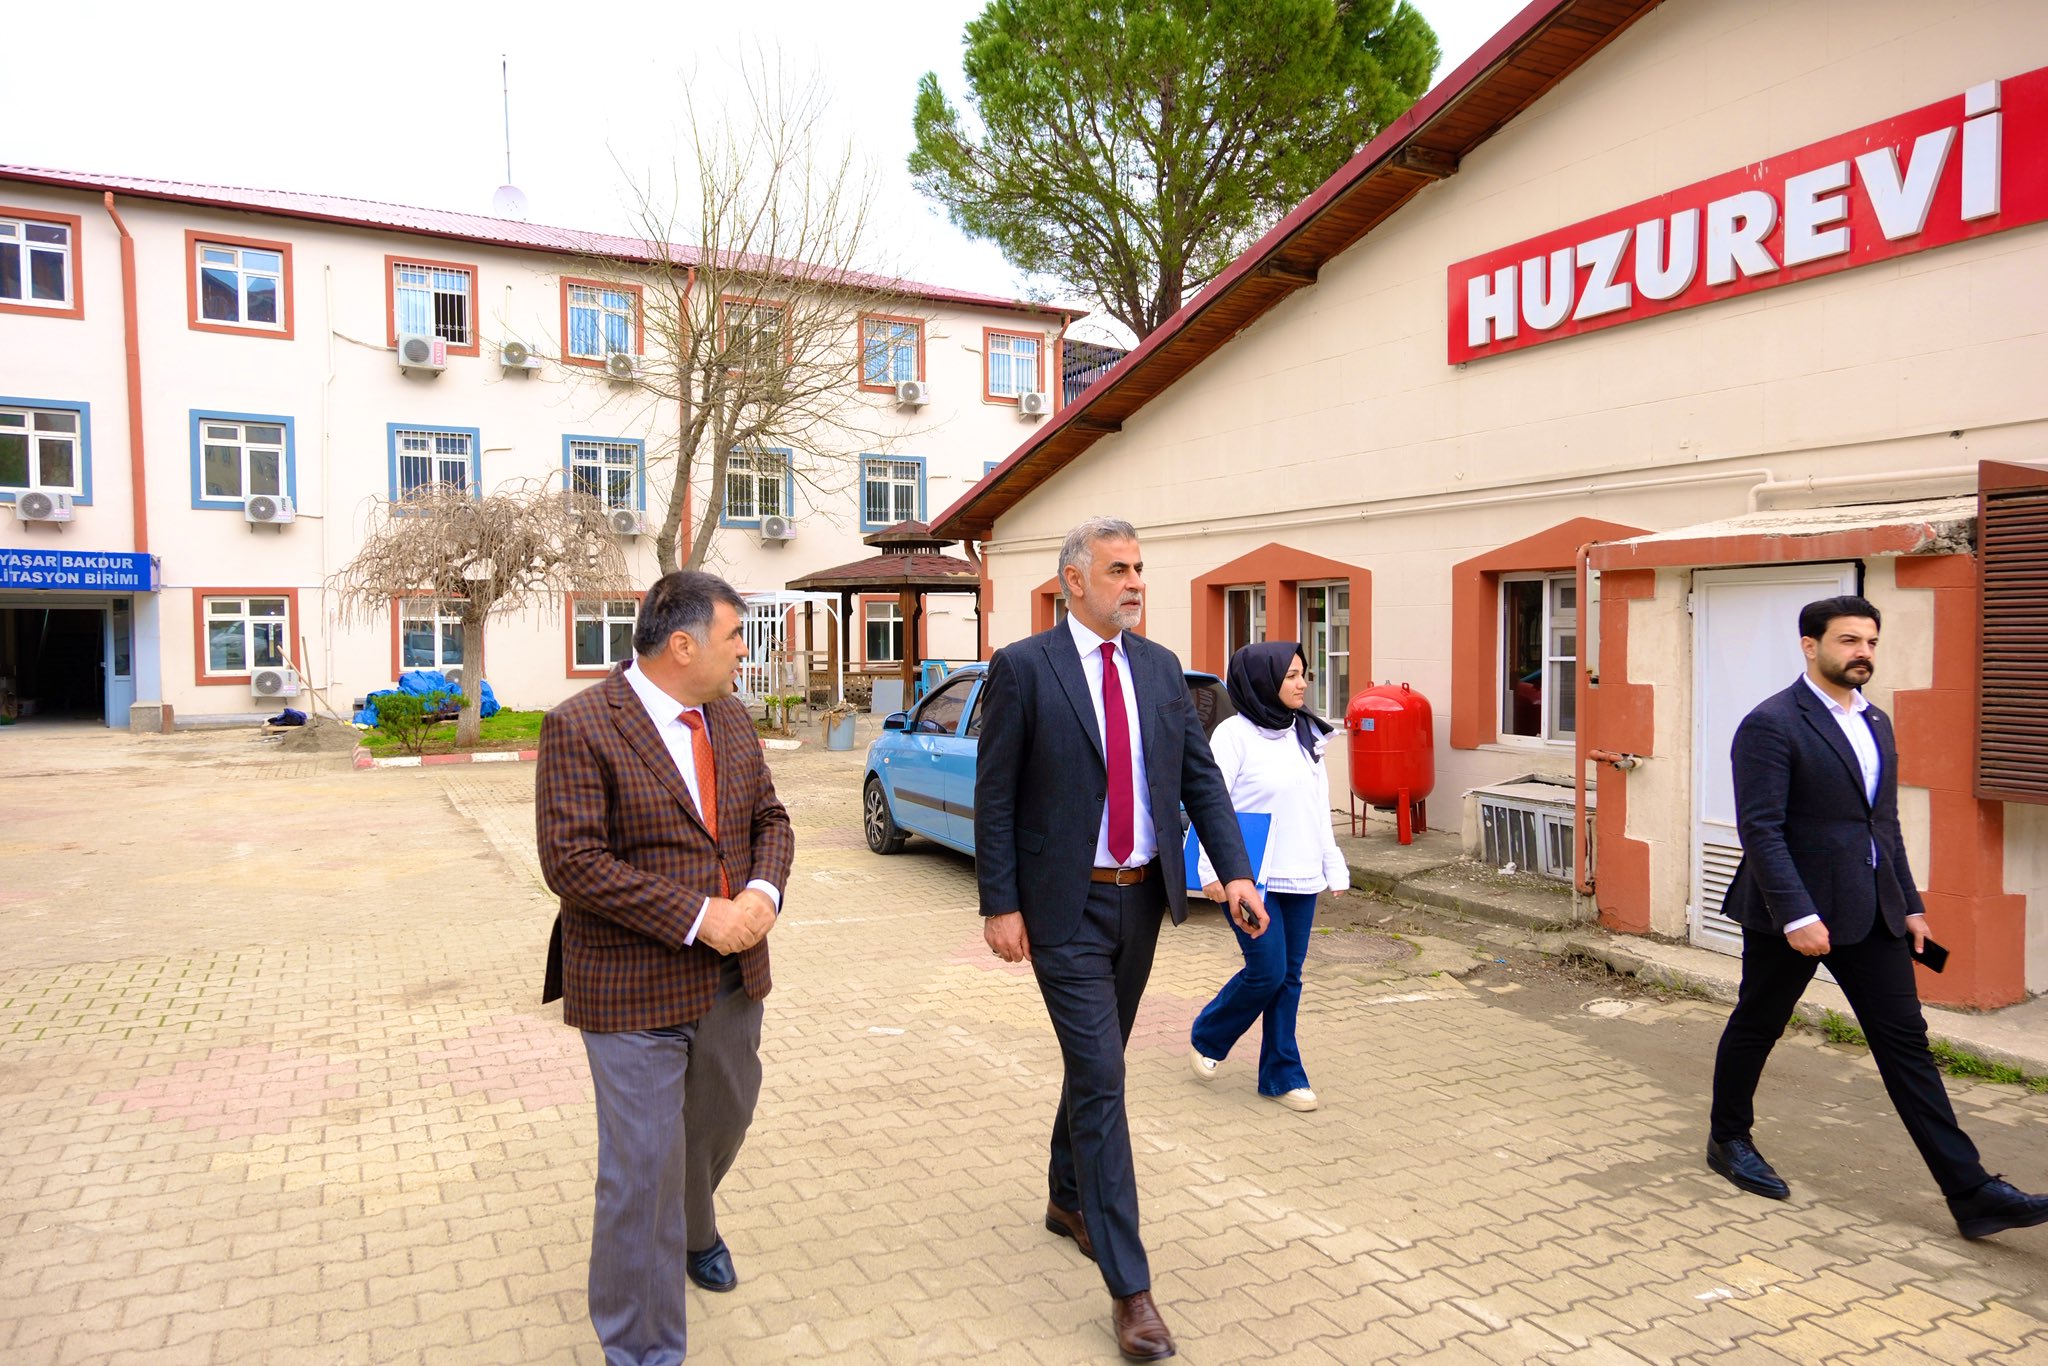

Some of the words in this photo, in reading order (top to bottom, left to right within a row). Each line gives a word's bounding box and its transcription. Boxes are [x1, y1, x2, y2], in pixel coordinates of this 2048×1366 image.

[1467, 79, 2002, 347] HUZUREVİ
[0, 554, 57, 569] YAŞAR
[62, 556, 134, 569] BAKDUR
[0, 568, 80, 584] İTASYON
